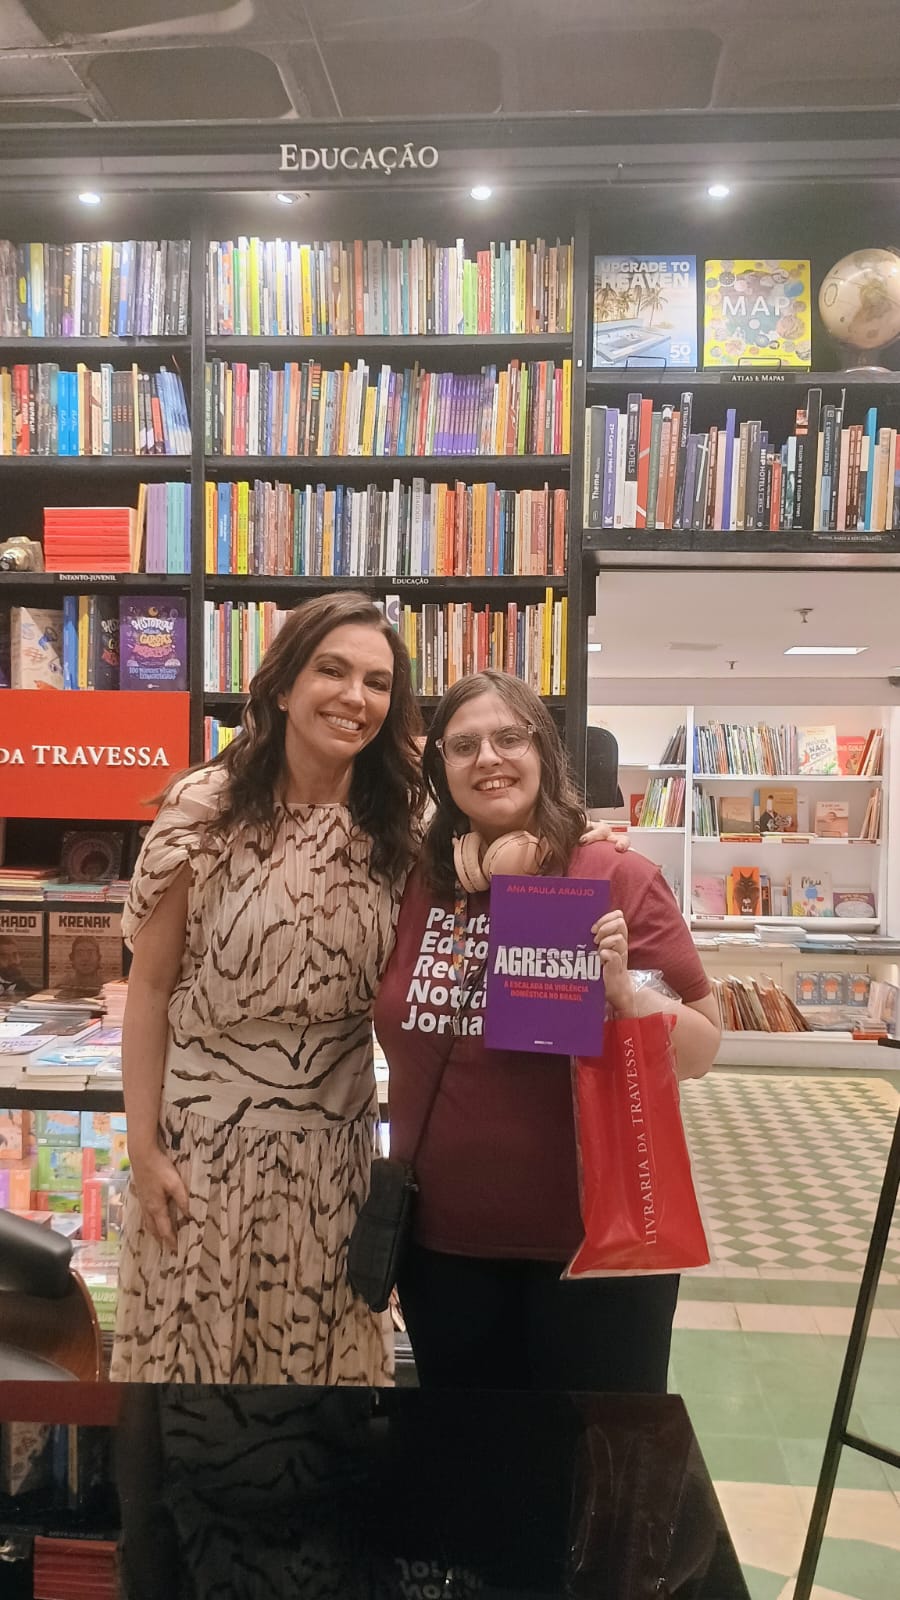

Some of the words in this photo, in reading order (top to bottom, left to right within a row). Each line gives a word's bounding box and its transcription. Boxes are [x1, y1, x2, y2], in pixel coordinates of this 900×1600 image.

[279, 142, 439, 175] EDUCAÇÃO
[600, 261, 667, 273] UPGRADE
[670, 261, 690, 273] TO
[600, 273, 689, 289] HEAVEN
[721, 295, 791, 317] MAP
[670, 342, 691, 358] 50
[761, 374, 785, 382] MAPAS
[628, 443, 636, 474] HOTELS
[592, 473, 600, 500] Theme
[758, 466, 766, 492] HOTELS
[391, 577, 430, 586] EDUCAÇÃO
[32, 744, 170, 767] TRAVESSA
[506, 884, 526, 894] ANA
[528, 885, 556, 896] PAULA
[0, 916, 37, 933] HADO
[58, 915, 111, 933] KRENAK
[493, 944, 601, 981] AGRESSÃO
[511, 981, 543, 991] ESCALADA
[544, 982, 554, 991] DA
[555, 982, 590, 993] VIOLÊNCIA
[511, 990, 547, 1000] DOMÉSTICA
[549, 992, 558, 1000] NO
[560, 992, 583, 1002] BRASIL
[622, 1036, 645, 1128] TRAVESSA
[636, 1133, 649, 1154] DA
[638, 1159, 658, 1246] LIVRARIA
